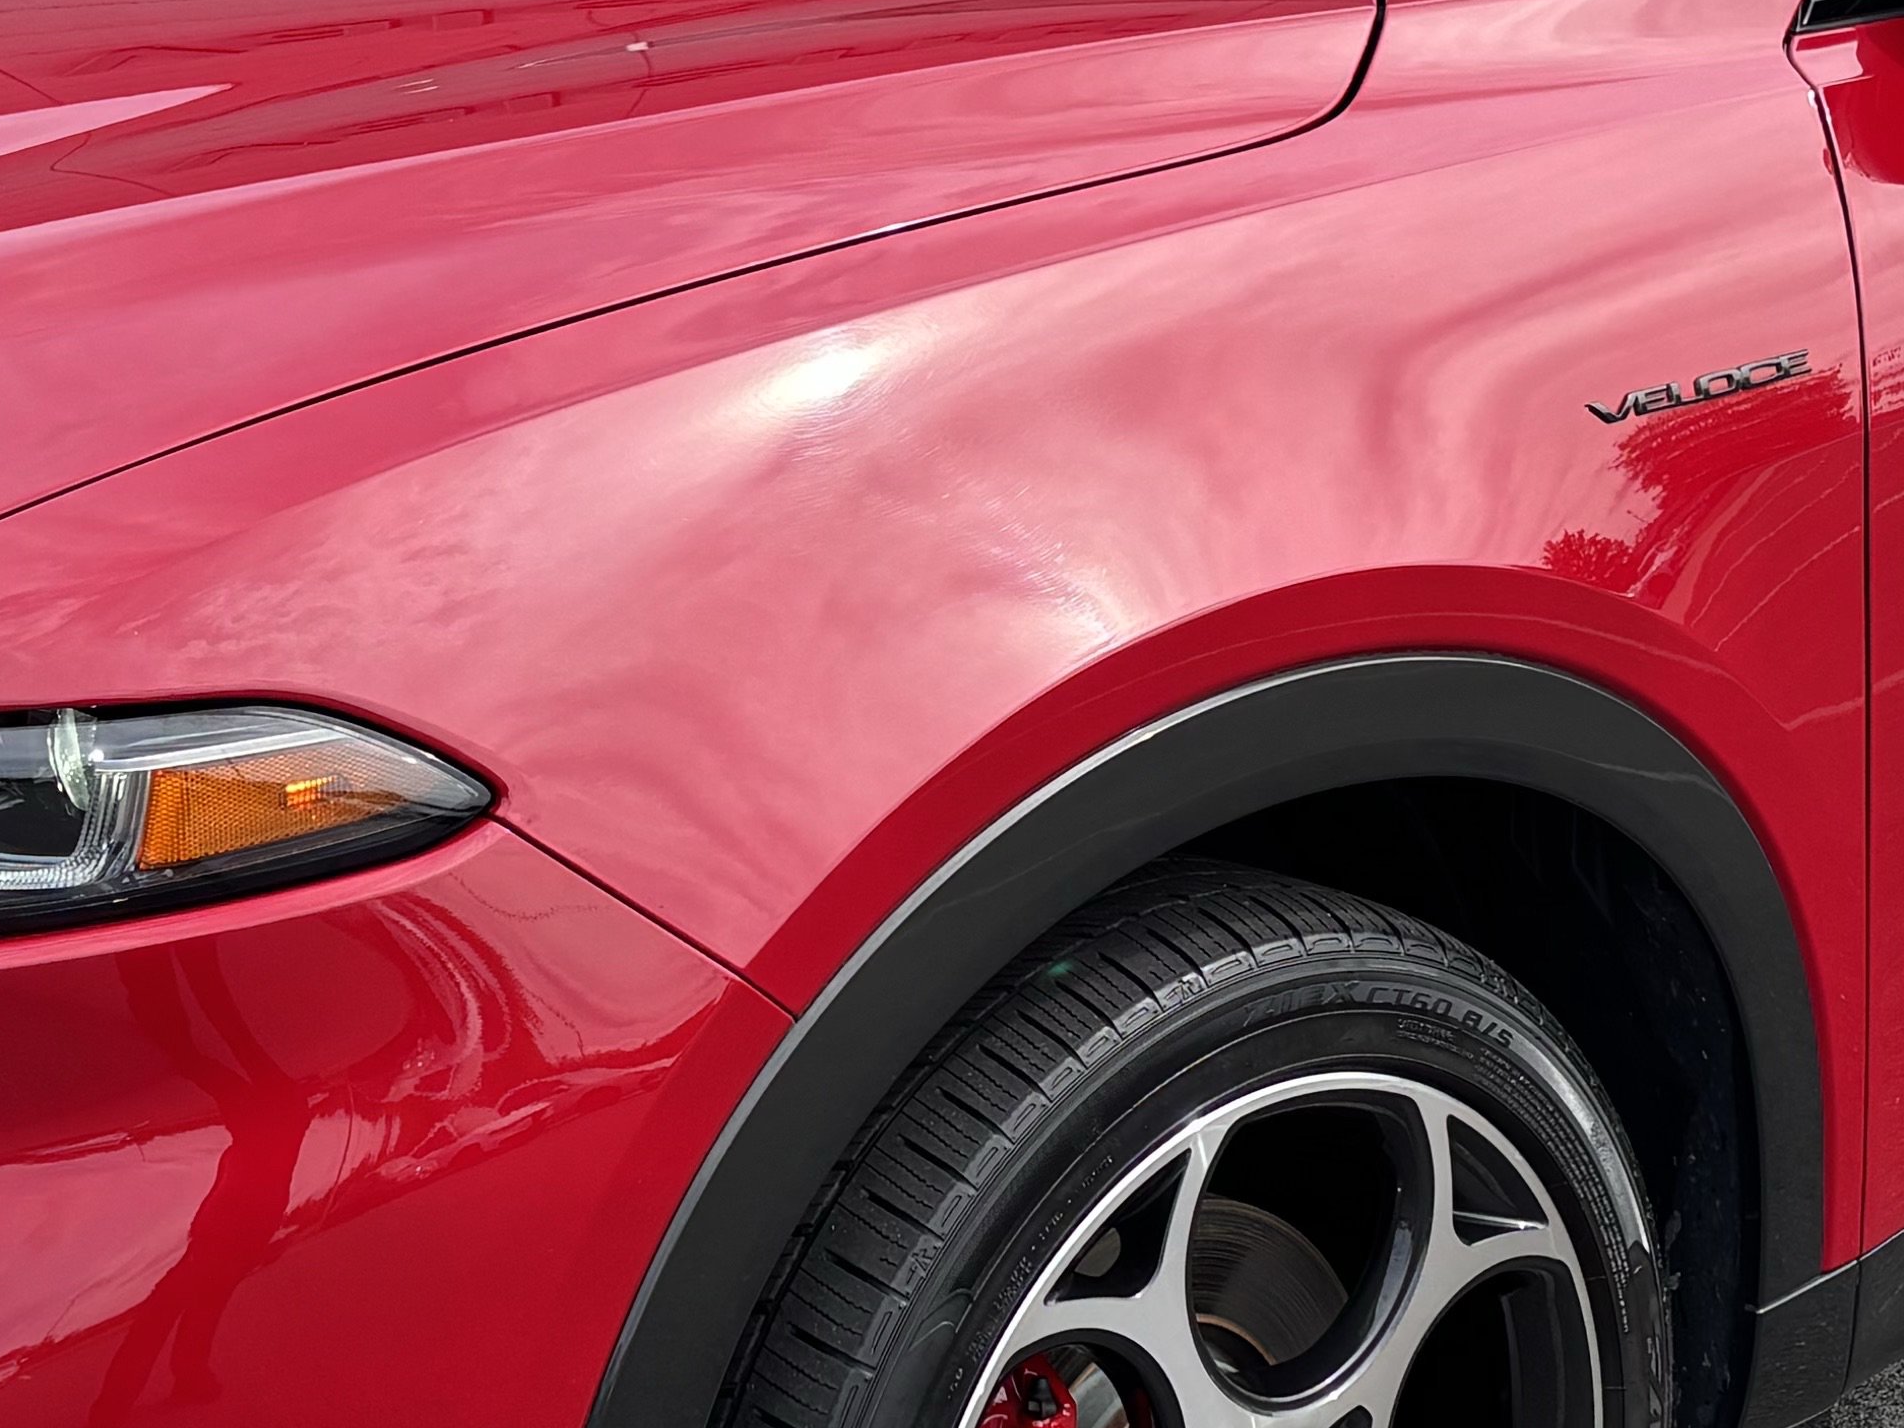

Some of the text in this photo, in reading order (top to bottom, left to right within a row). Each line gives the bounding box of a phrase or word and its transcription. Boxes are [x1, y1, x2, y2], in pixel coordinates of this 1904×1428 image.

[1584, 348, 1813, 425] VELOCE
[1366, 986, 1454, 1017] CT60
[1459, 1010, 1515, 1050] A/S
